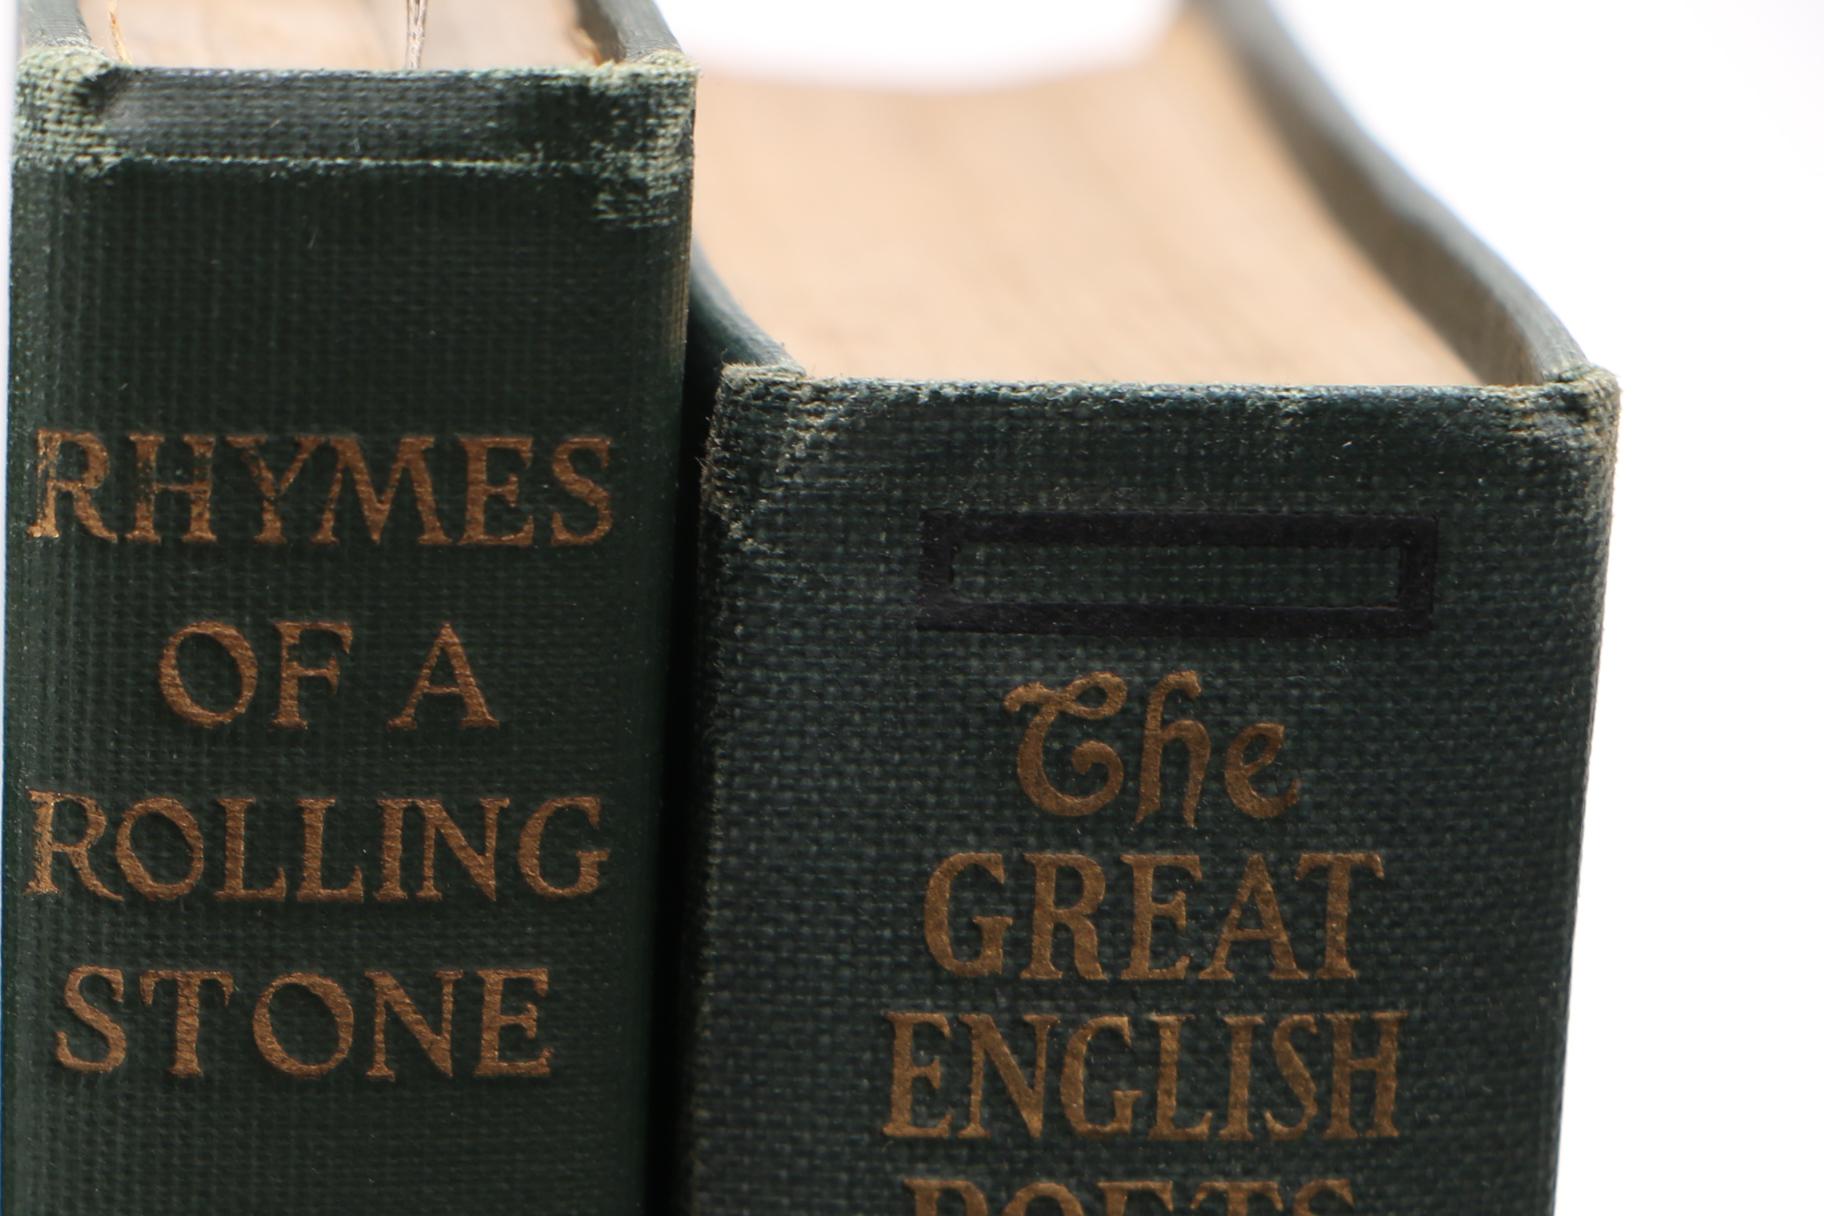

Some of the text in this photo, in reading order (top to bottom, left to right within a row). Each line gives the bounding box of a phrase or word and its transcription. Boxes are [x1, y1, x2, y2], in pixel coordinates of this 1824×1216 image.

[26, 429, 615, 548] RHYMES
[159, 620, 500, 731] OF A
[1002, 670, 1302, 829] The
[25, 789, 612, 904] ROLLING
[923, 851, 1386, 982] GREAT
[55, 964, 554, 1082] STONE
[881, 1010, 1409, 1142] ENGLISH
